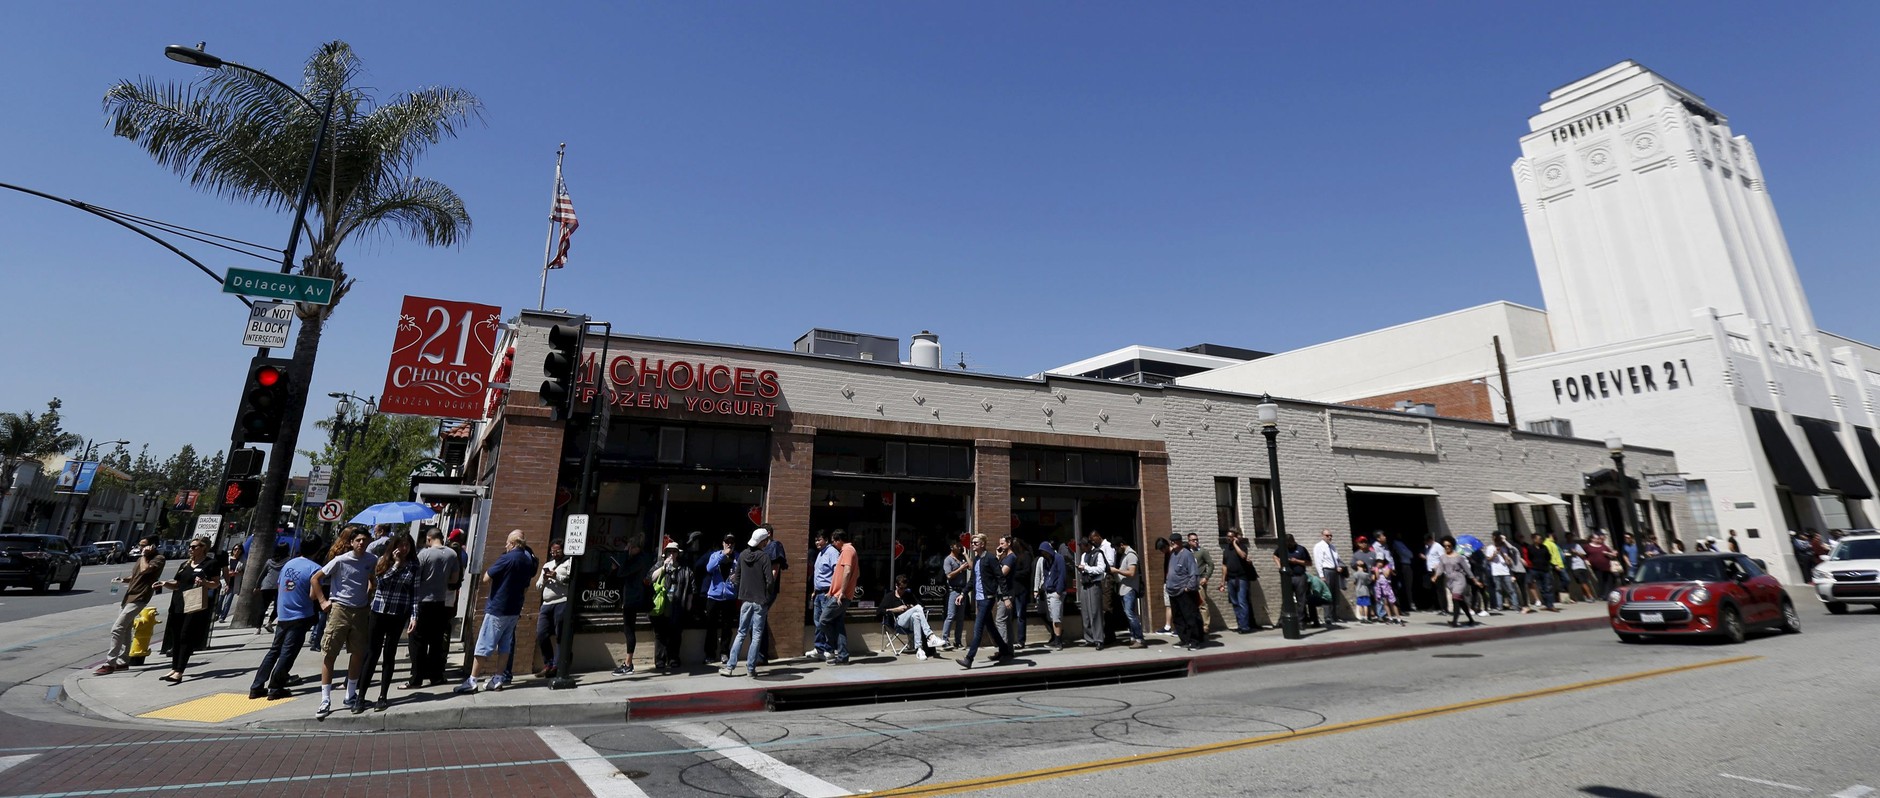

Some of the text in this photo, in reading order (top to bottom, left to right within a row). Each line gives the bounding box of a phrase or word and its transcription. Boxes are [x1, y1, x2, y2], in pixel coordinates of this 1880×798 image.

[1551, 104, 1631, 147] FOREVER 21
[233, 276, 324, 296] Delacey Av
[253, 306, 291, 320] DO NOT
[246, 334, 285, 344] INTERSECTION
[251, 321, 285, 333] BLOCK
[417, 306, 473, 366] 21
[609, 355, 780, 399] CHOICES
[1552, 359, 1694, 405] FOREVER 21
[387, 395, 479, 410] FROZEN YOGURT
[575, 386, 780, 418] RZEN YOGURT
